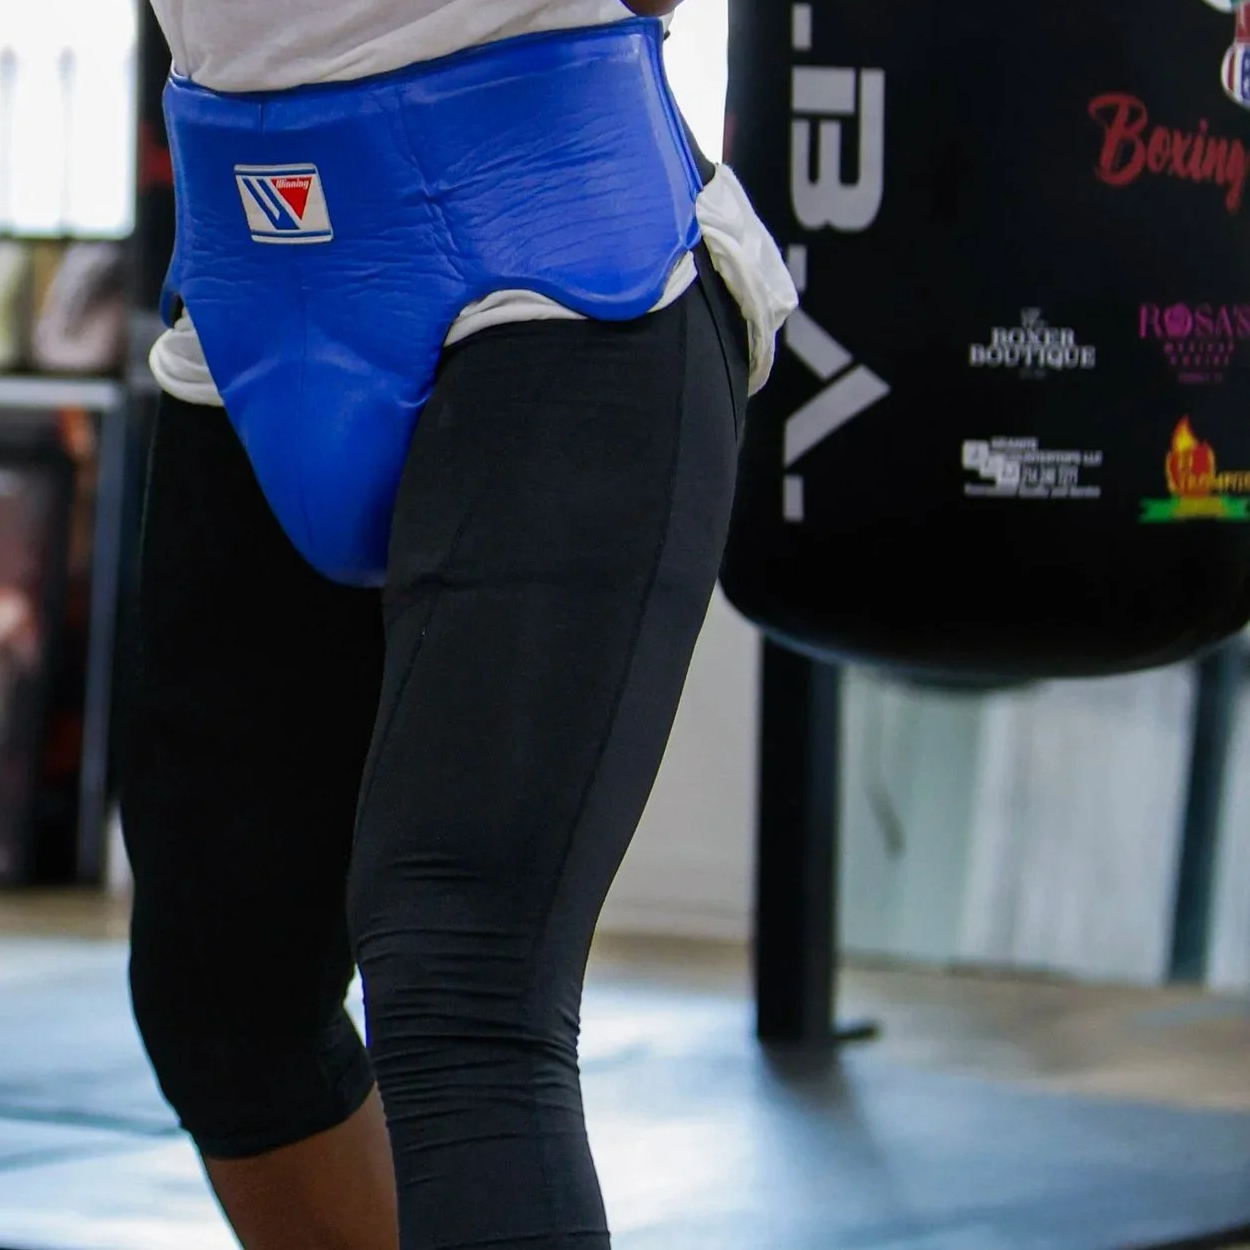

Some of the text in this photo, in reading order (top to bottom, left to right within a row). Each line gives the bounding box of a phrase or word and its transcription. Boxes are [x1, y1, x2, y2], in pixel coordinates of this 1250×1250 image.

[1087, 92, 1247, 212] Boxing
[991, 326, 1075, 348] BOXER
[969, 343, 1096, 370] BOUTIQUE
